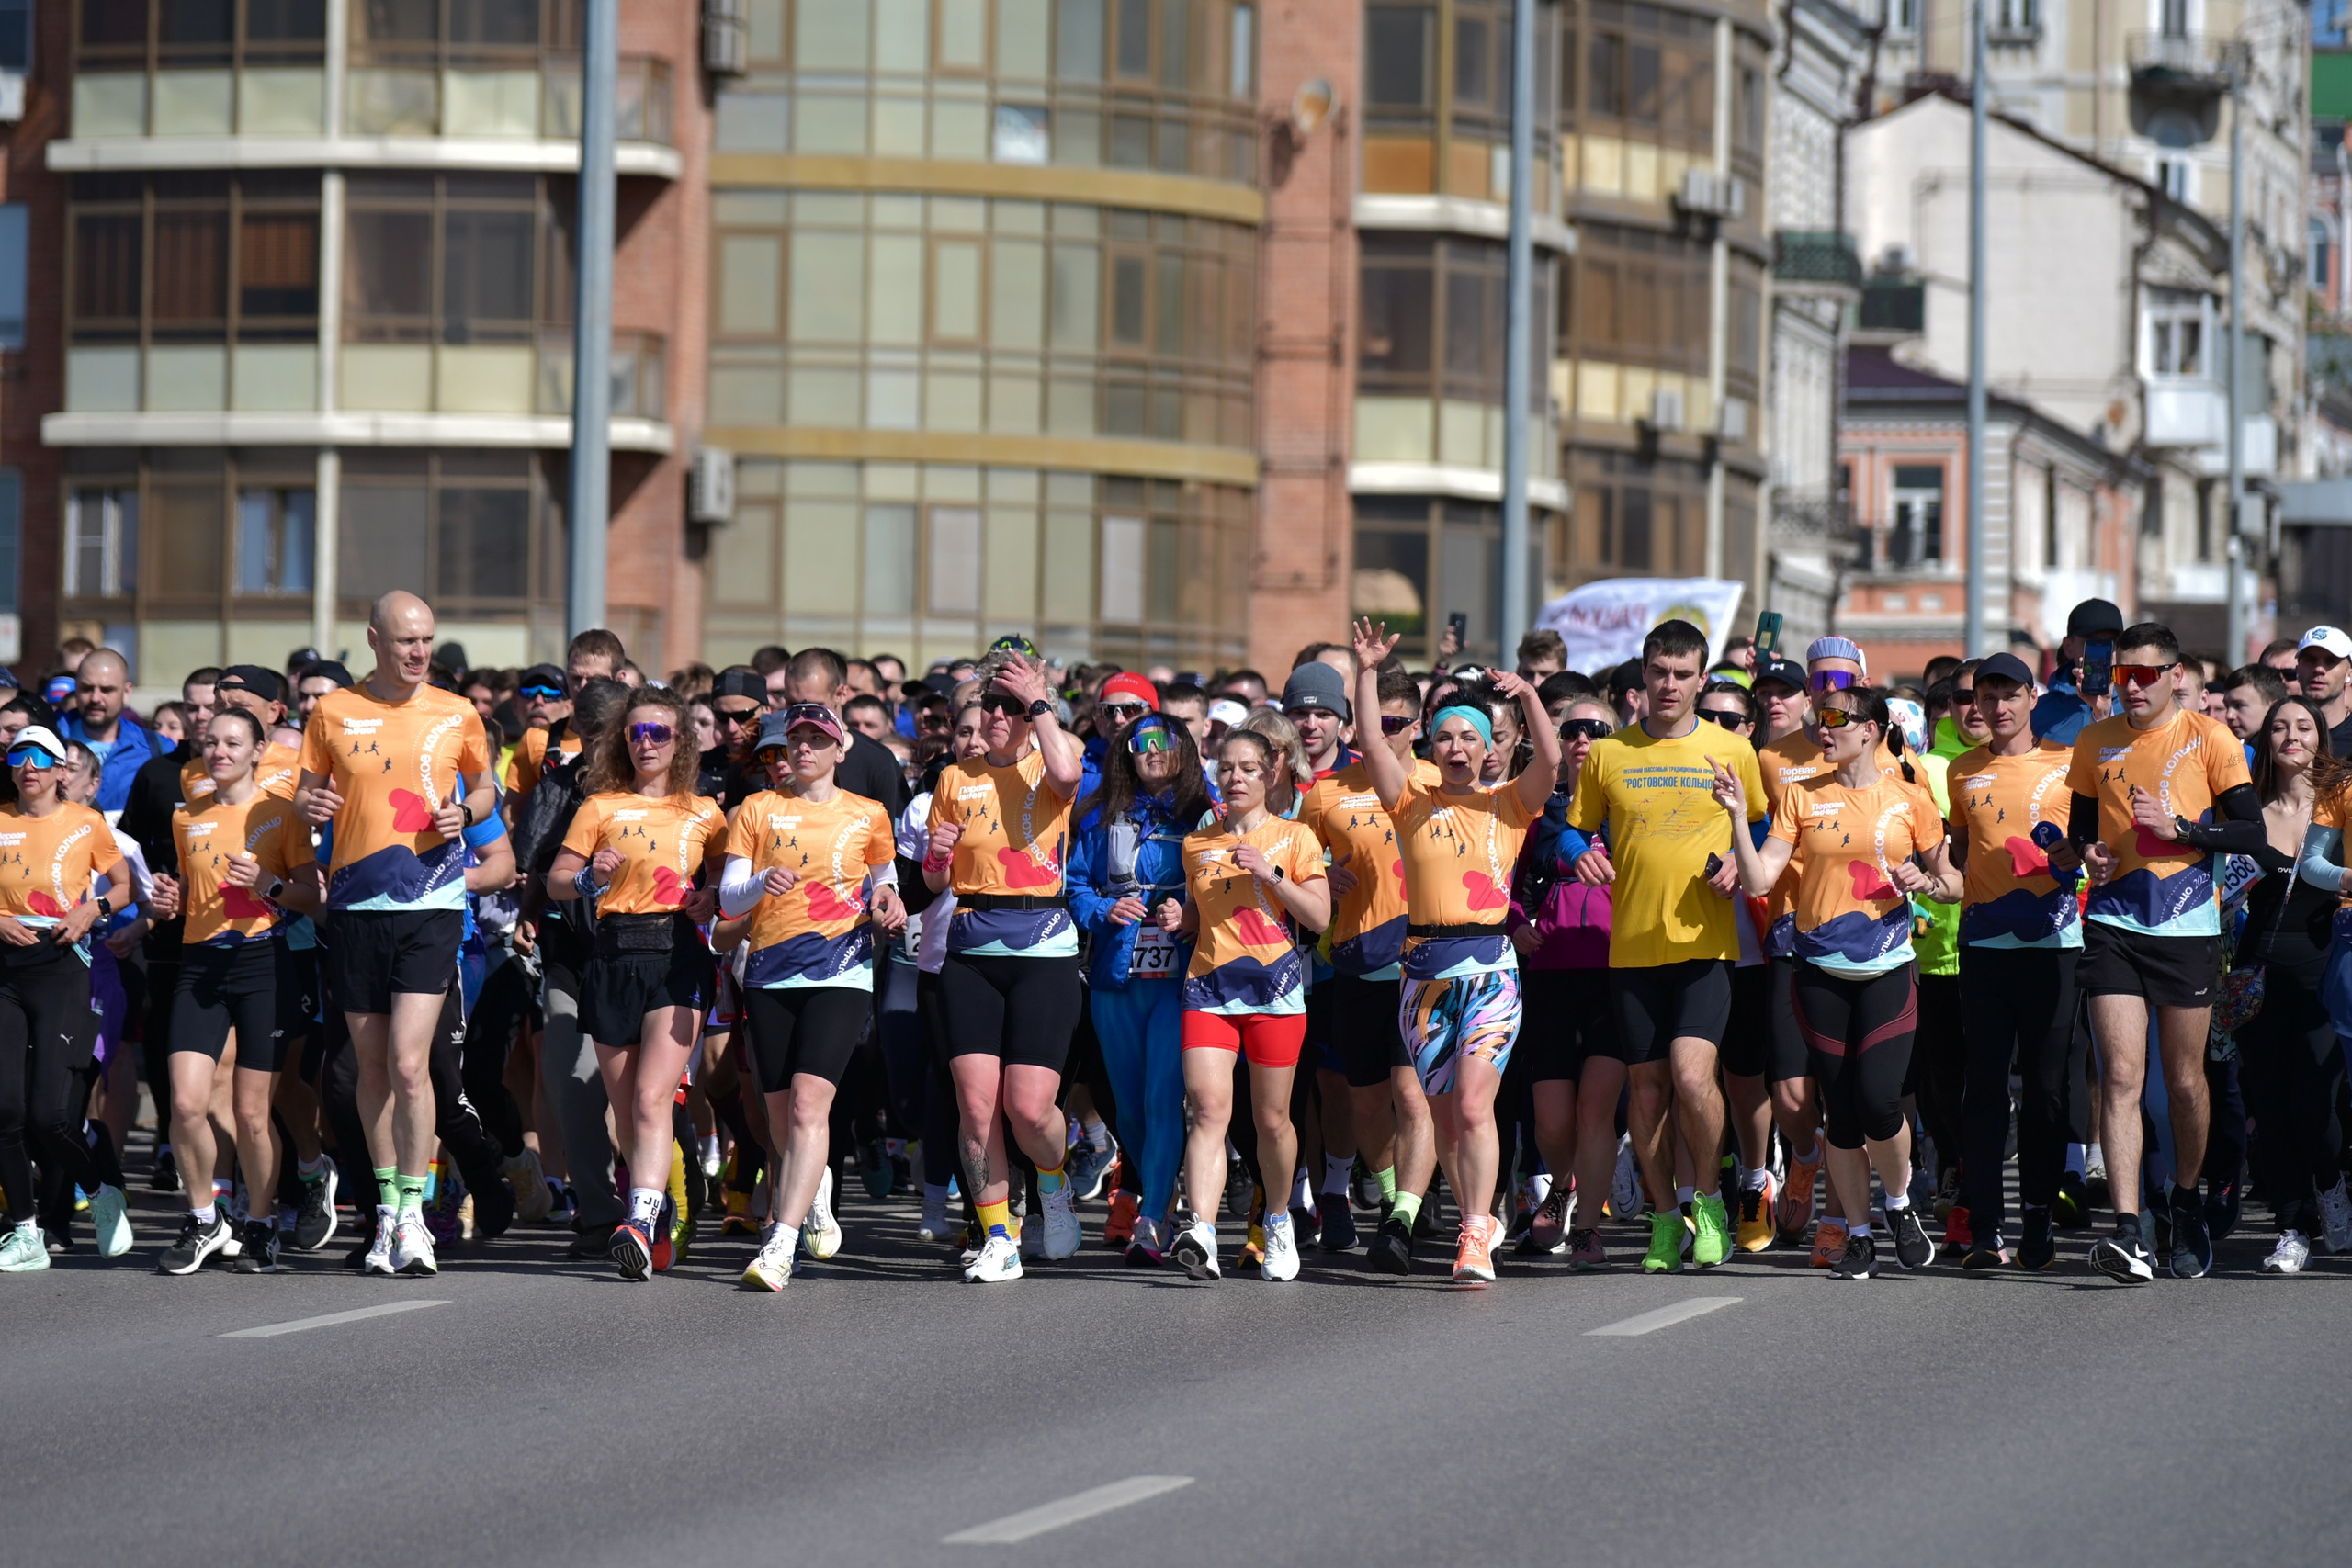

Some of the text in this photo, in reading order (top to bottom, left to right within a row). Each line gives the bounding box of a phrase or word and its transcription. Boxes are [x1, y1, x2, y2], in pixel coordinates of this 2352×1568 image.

[259, 769, 292, 790] льцо
[1779, 767, 1817, 777] Первая
[244, 816, 283, 851] кольцо
[1263, 836, 1293, 862] льцо
[51, 824, 92, 913] товское кольцо
[423, 863, 446, 897] ольцо
[2170, 886, 2194, 921] ольцо
[1038, 913, 1061, 943] ольцо
[2052, 903, 2070, 937] ольцо
[1130, 946, 1175, 968] 737
[1878, 928, 1895, 958] ольцо
[836, 945, 855, 976] ольцо
[1273, 972, 1289, 1002] ольцо
